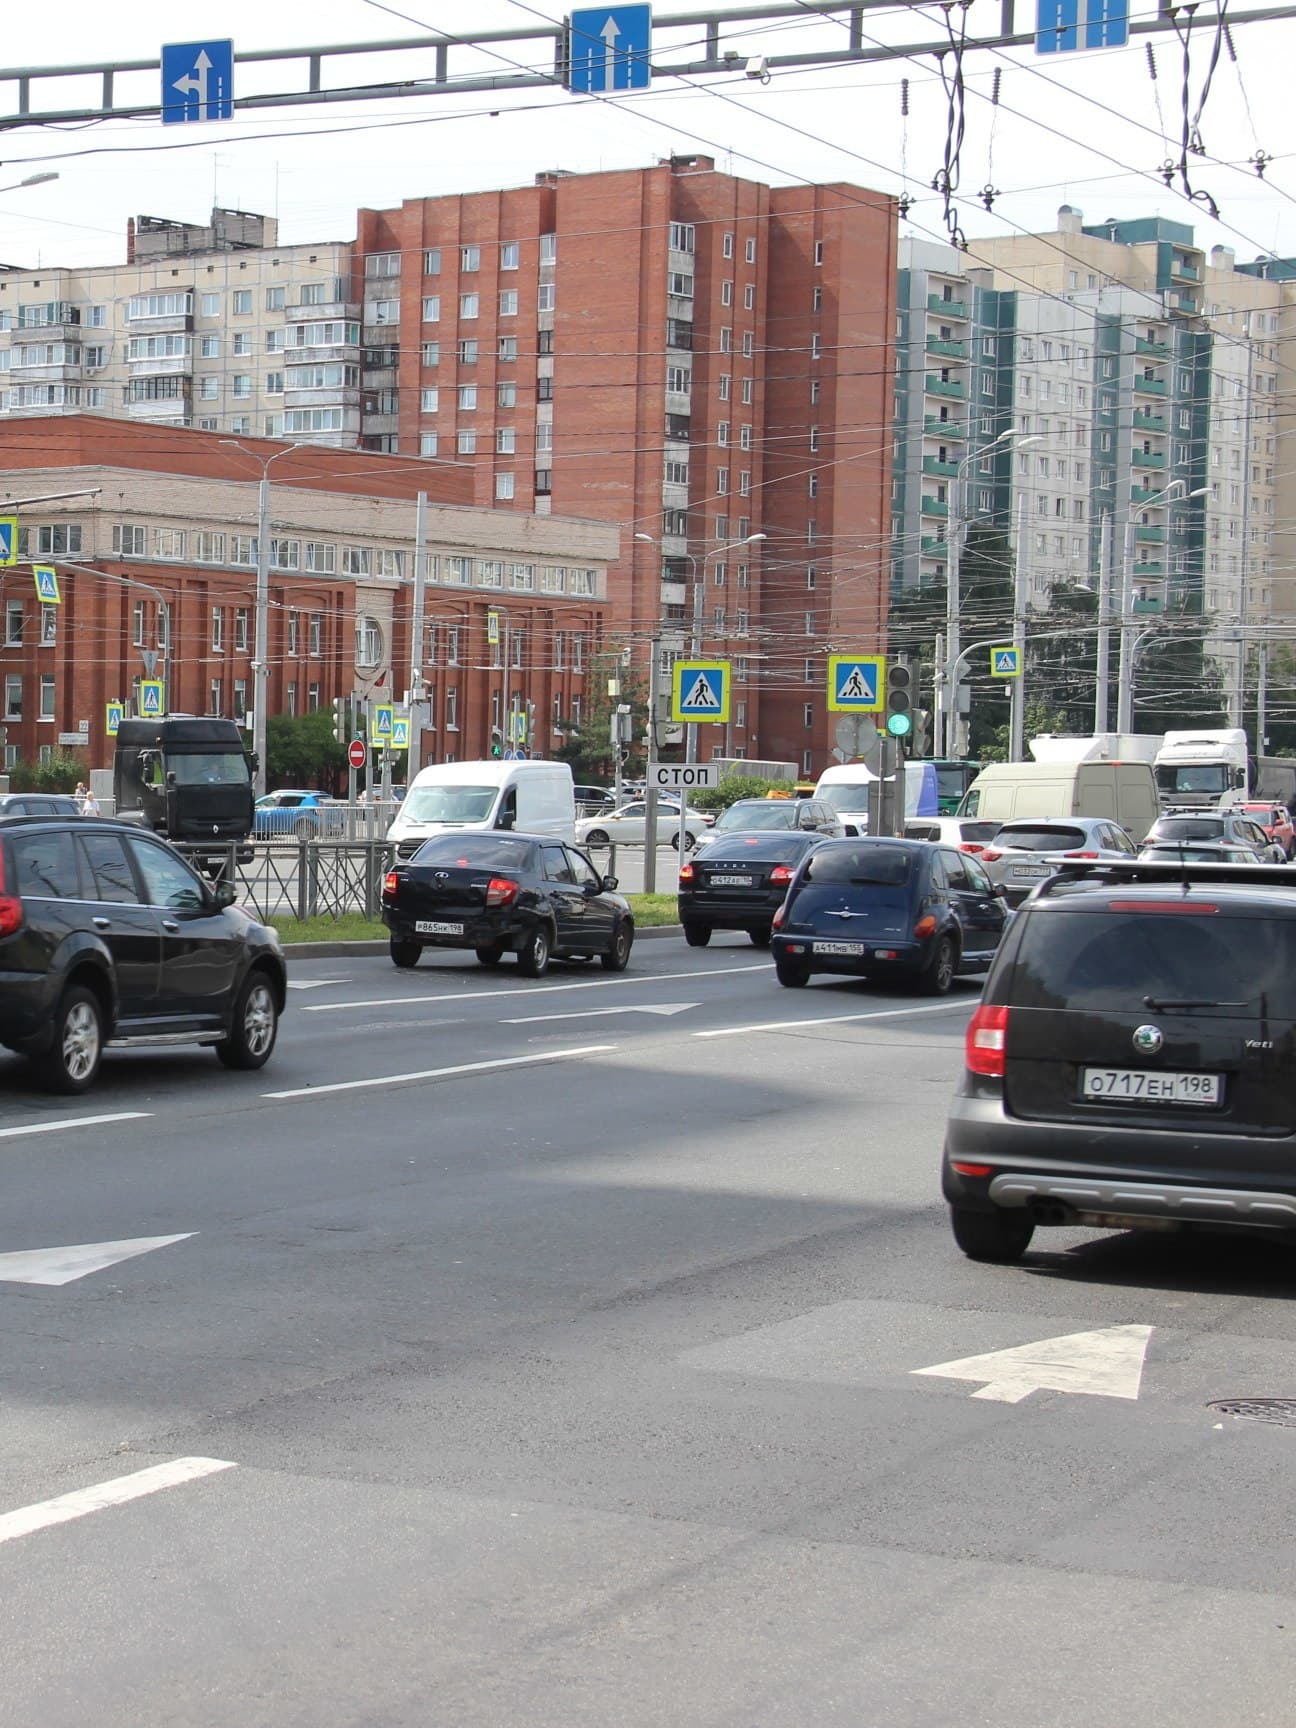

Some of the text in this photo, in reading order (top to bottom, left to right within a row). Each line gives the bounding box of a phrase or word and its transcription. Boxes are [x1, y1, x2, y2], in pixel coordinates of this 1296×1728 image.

[657, 768, 708, 785] СТОП
[1245, 1039, 1274, 1049] Yeti
[1090, 1073, 1212, 1097] О717ЕН 198
